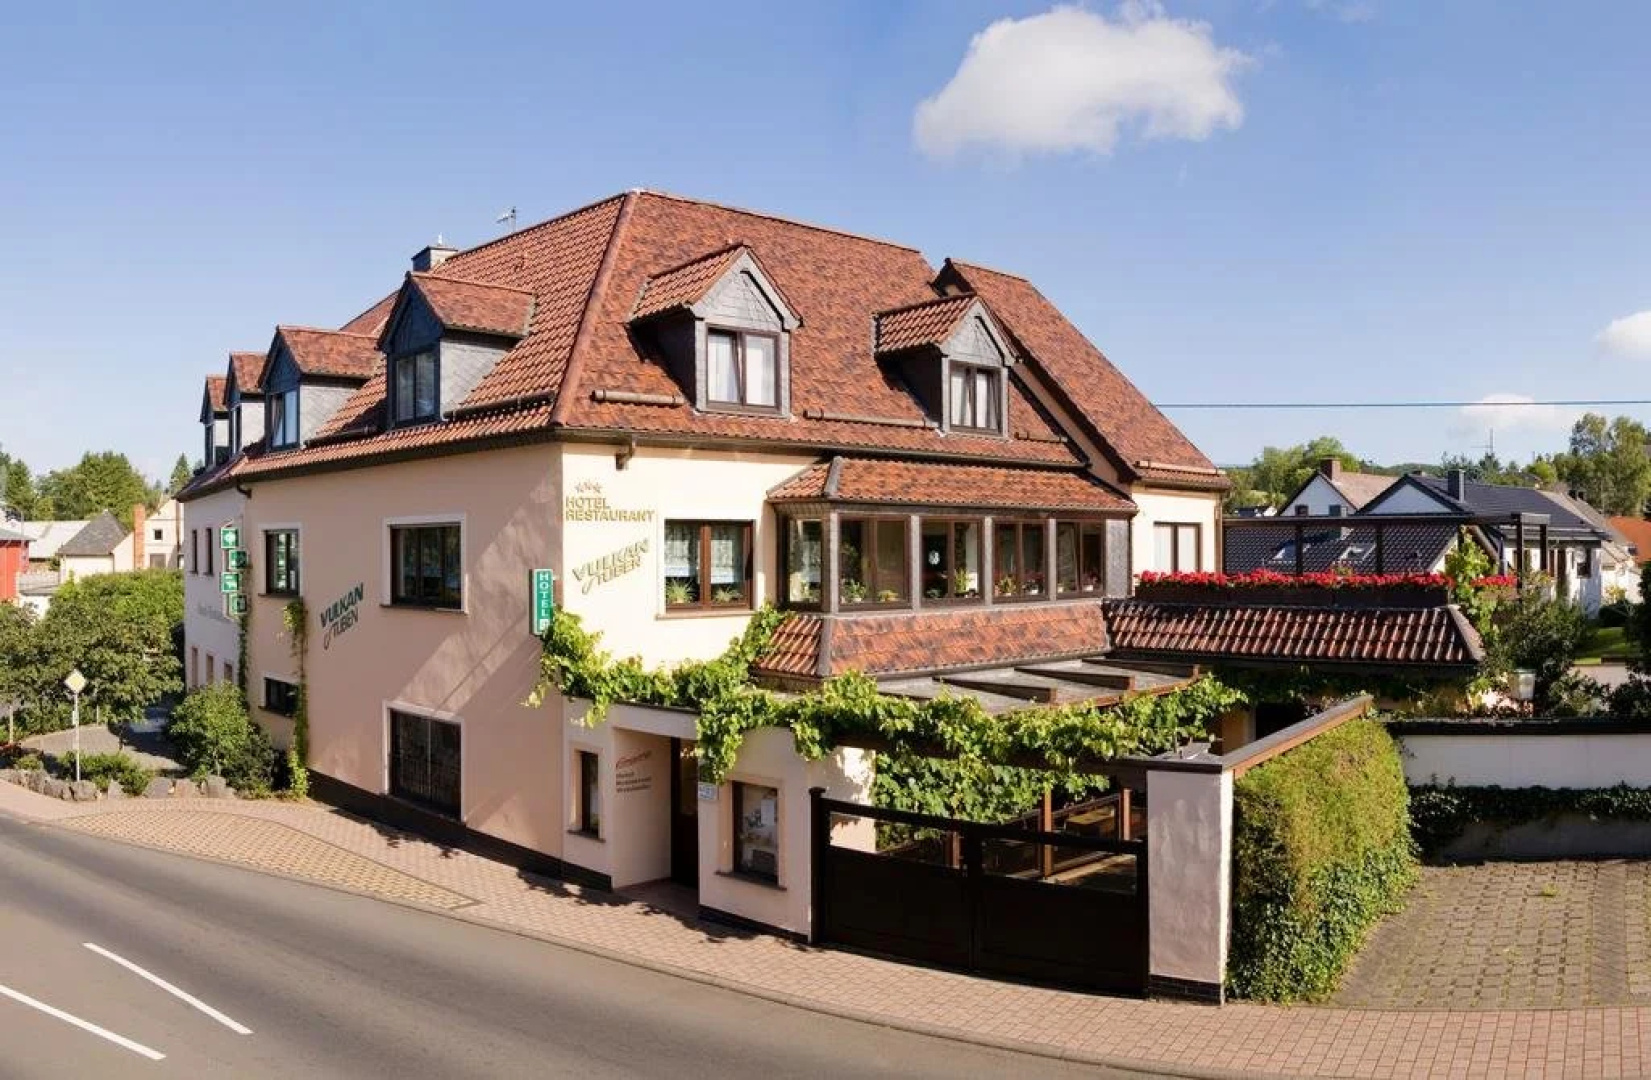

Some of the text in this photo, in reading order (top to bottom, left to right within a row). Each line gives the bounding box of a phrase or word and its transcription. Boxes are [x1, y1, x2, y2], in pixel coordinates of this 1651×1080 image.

[565, 497, 611, 509] HOTEL
[565, 510, 655, 522] RESTAURANT
[572, 538, 649, 582] VULKAN
[320, 582, 364, 628] VULKAN
[539, 571, 549, 617] HOTEL
